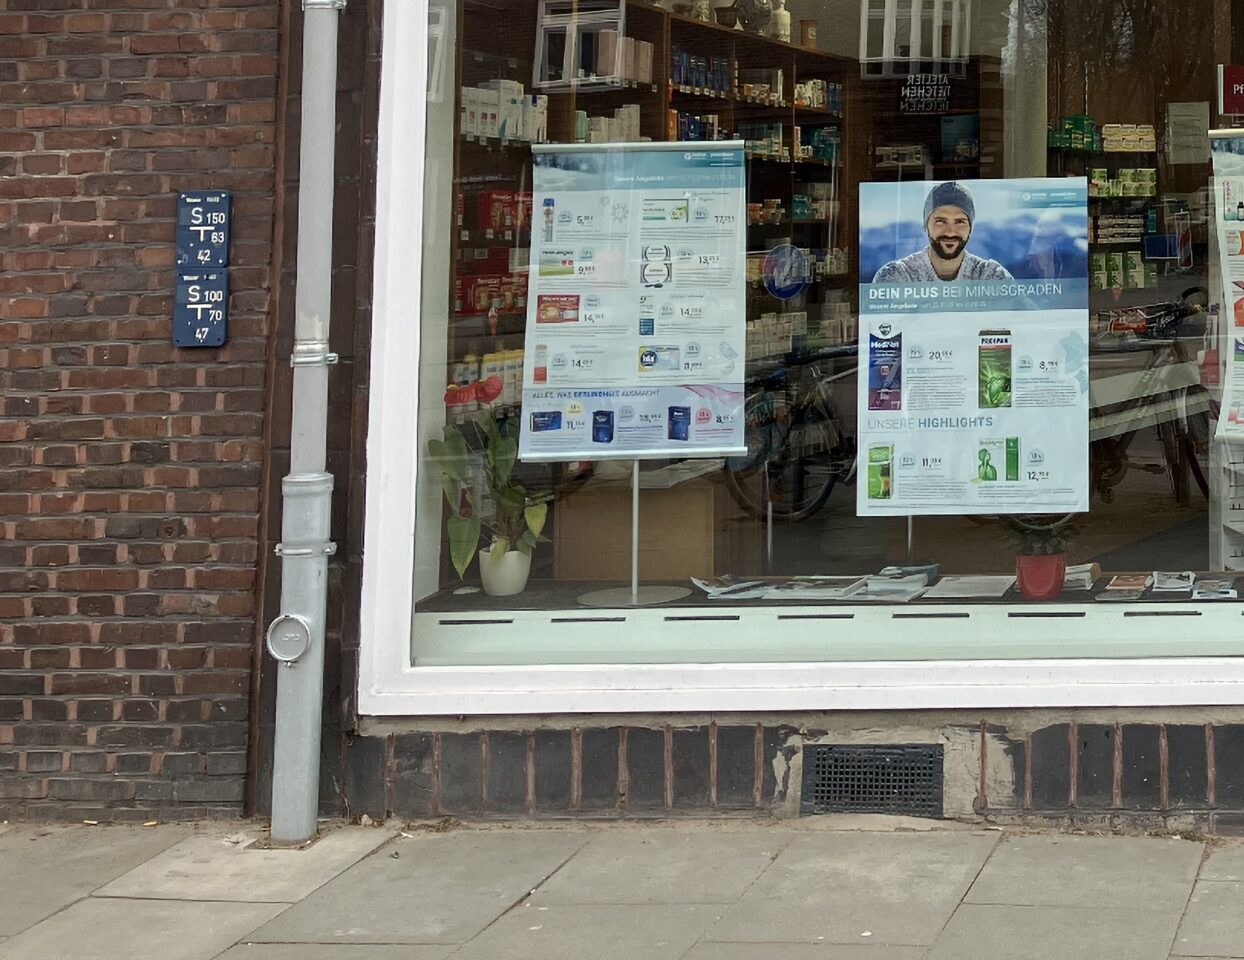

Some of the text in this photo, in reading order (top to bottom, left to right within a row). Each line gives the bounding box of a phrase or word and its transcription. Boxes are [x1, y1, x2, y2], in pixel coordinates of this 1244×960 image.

[190, 207, 226, 225] S 150
[189, 226, 216, 242] T
[197, 249, 211, 262] 42
[188, 285, 223, 302] S 100
[868, 283, 1062, 300] DEIN PLUS BEI MINUSGRADEN
[186, 304, 223, 322] T 70
[195, 327, 210, 340] 47
[867, 417, 993, 430] UNSERE HIGHLIGHTS
